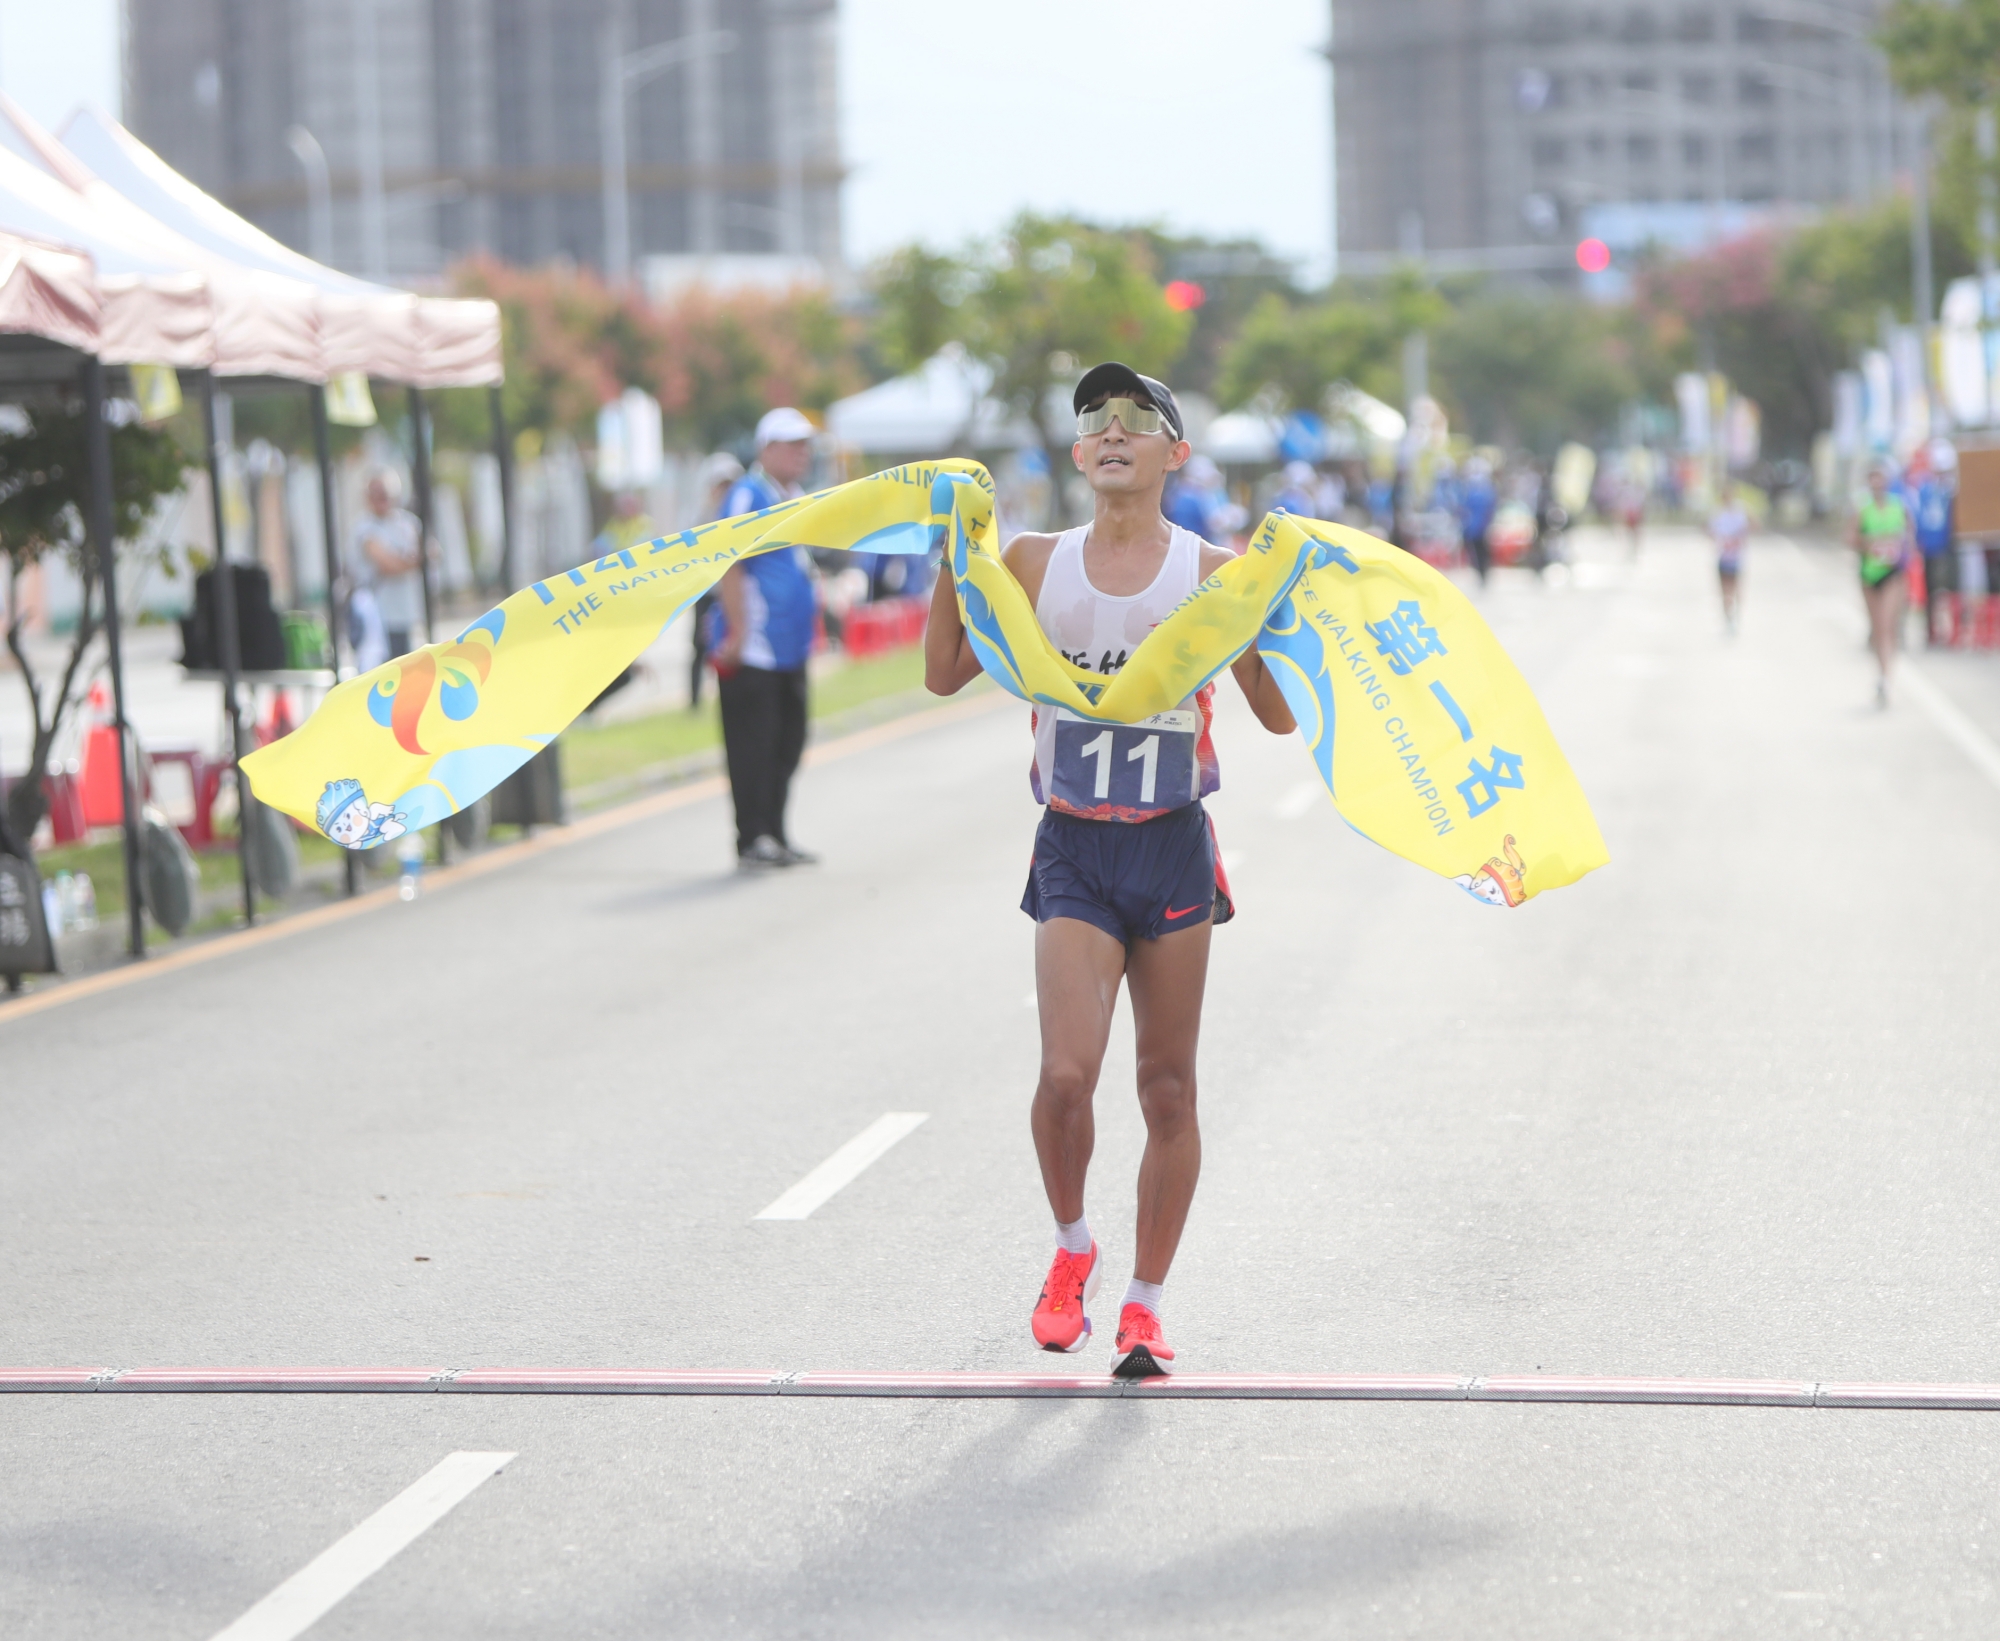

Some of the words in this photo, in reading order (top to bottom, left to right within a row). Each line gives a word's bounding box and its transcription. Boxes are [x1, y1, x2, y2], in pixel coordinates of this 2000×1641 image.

[552, 592, 603, 635] THE
[608, 546, 741, 596] NATIONAL
[1081, 730, 1160, 803] 11
[1315, 609, 1391, 711] WALKING
[1385, 717, 1455, 836] CHAMPION
[1364, 600, 1526, 819] 第一名
